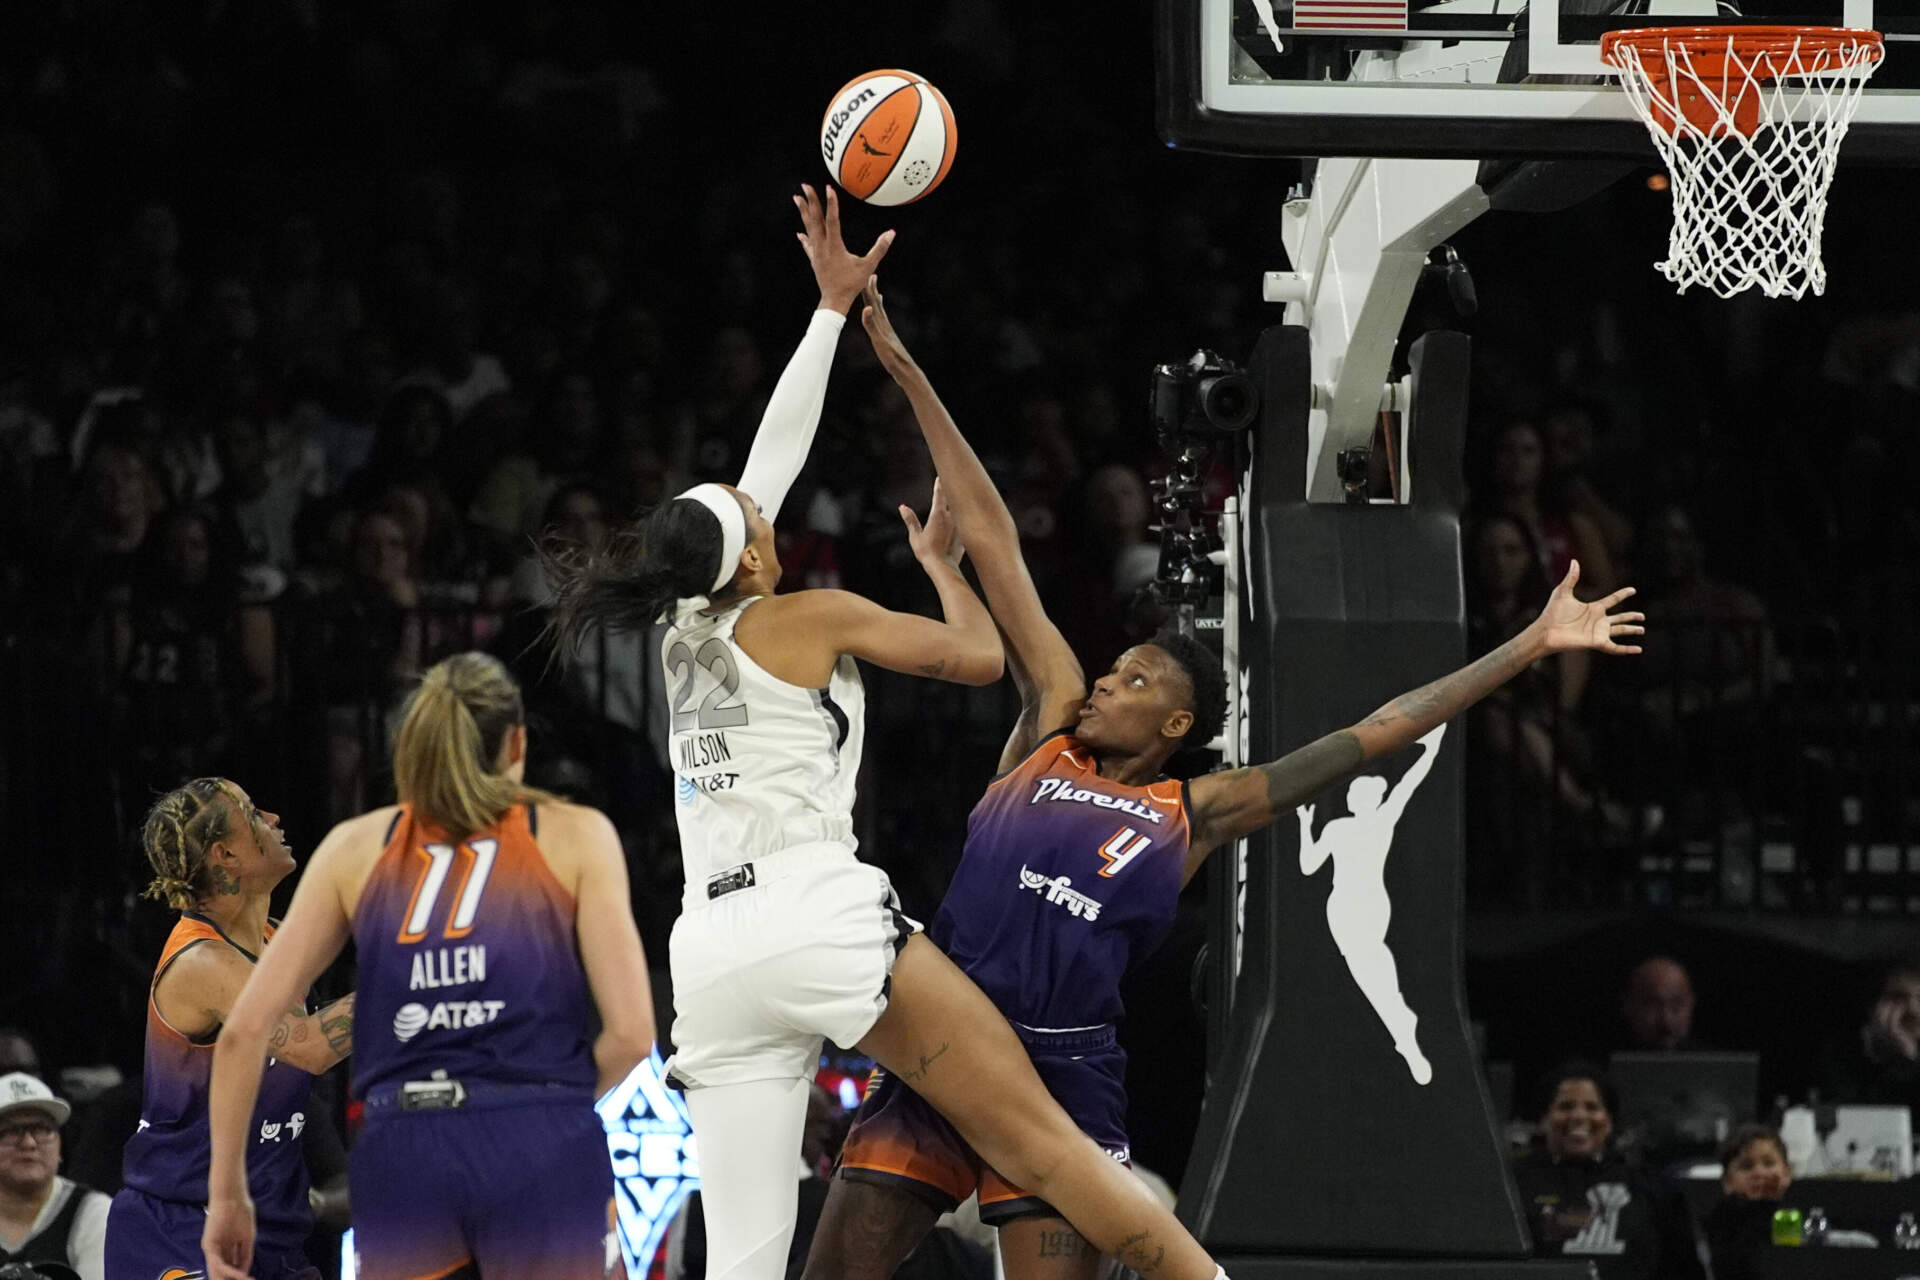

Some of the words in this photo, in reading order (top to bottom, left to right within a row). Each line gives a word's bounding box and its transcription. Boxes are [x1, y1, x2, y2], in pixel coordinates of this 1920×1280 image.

[823, 87, 877, 162] Wilson
[666, 637, 749, 736] 22
[1031, 778, 1165, 823] Phoenix
[1097, 825, 1152, 878] 4
[397, 838, 498, 944] 11
[410, 944, 486, 991] ALLEN
[427, 1000, 506, 1030] AT&T
